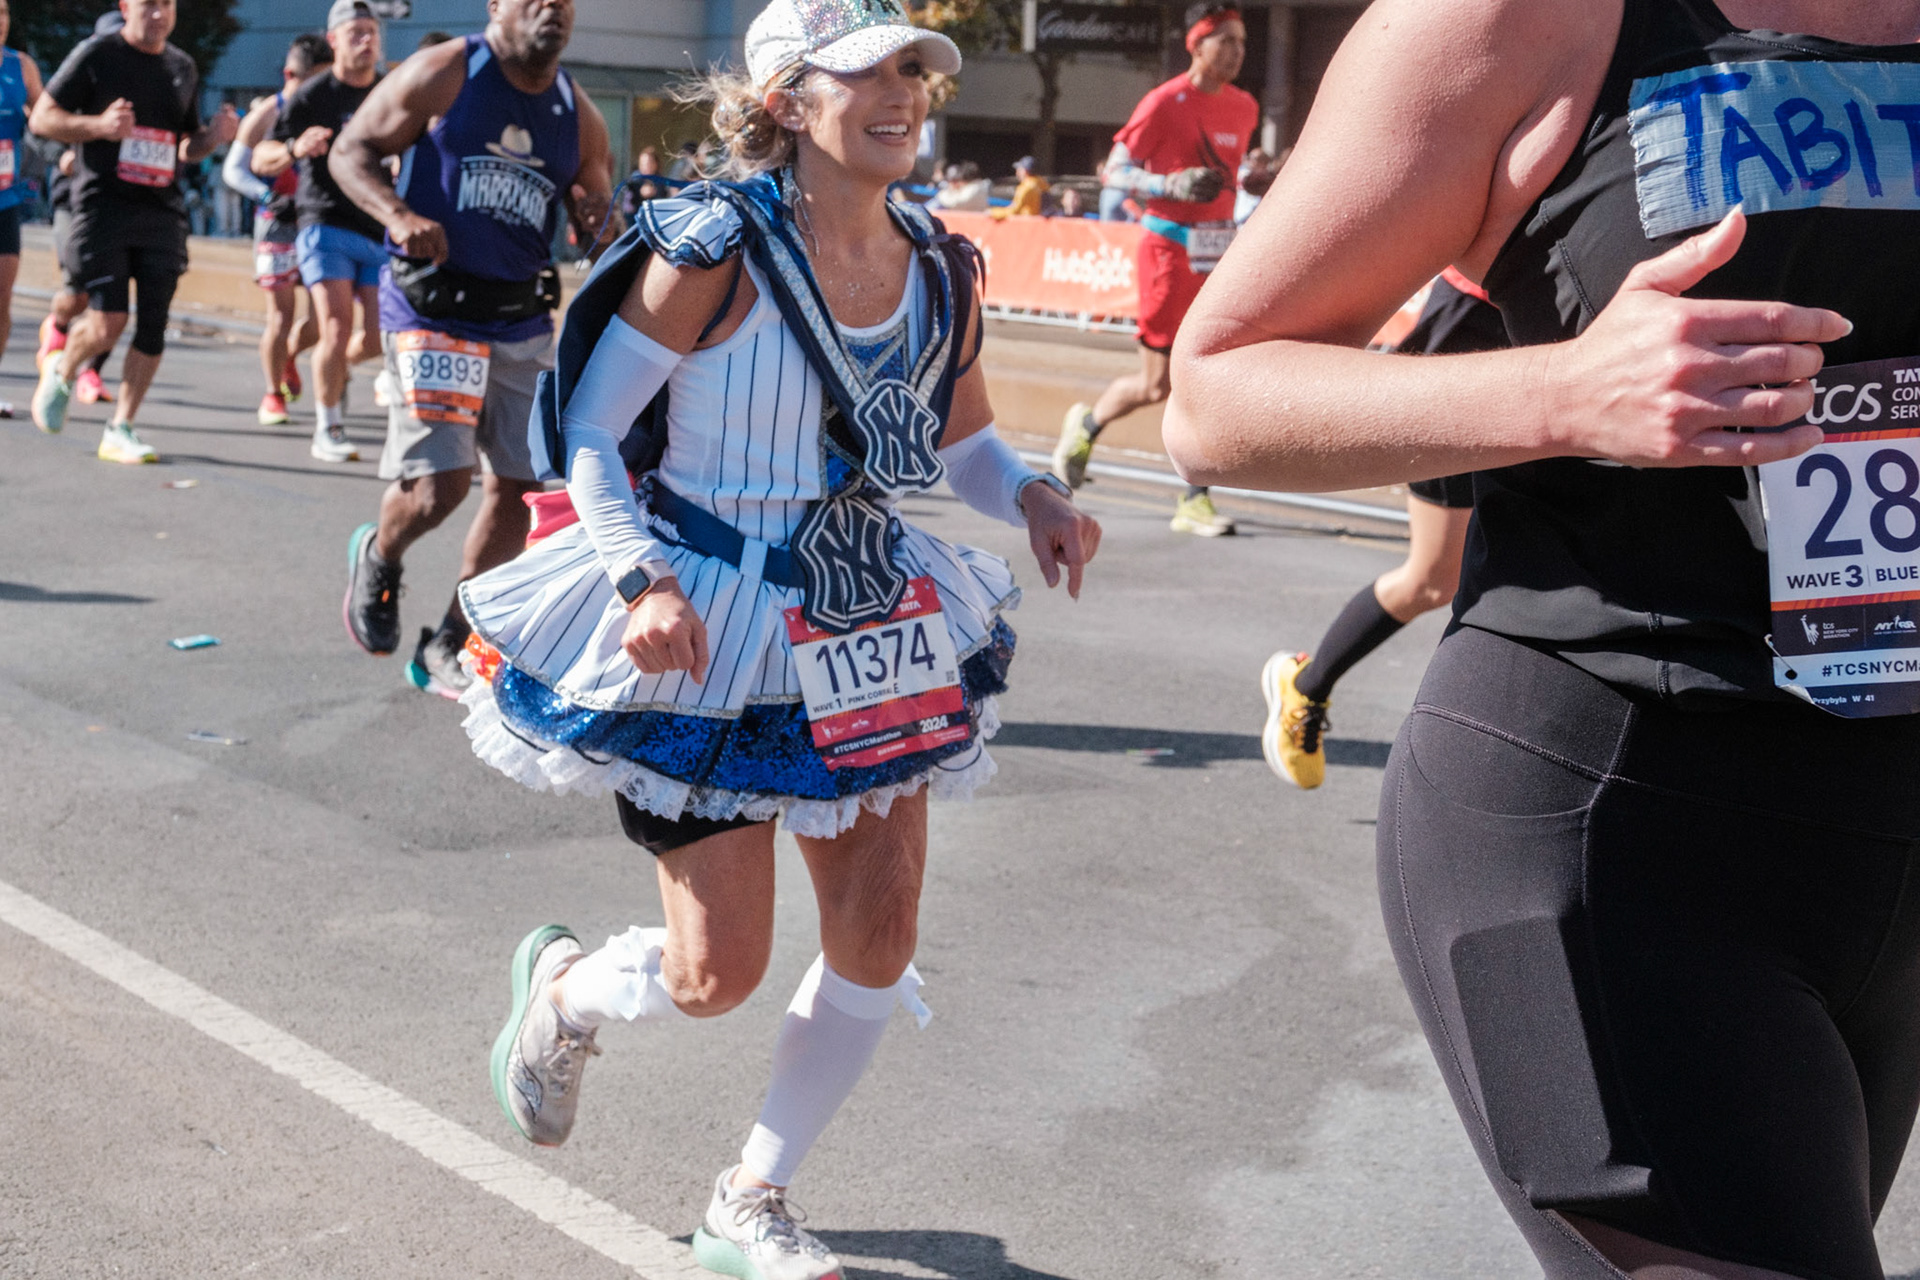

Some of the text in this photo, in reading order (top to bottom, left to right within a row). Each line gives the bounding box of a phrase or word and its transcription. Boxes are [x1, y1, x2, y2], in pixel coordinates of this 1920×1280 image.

[1647, 72, 1920, 211] TABIT
[1042, 244, 1133, 292] HubSpot
[404, 353, 484, 386] 39893
[1806, 378, 1883, 424] tcs
[865, 386, 942, 485] NY
[1796, 448, 1920, 560] 28
[809, 499, 899, 621] NY
[1786, 565, 1919, 589] WAVE 3 BLUE
[899, 601, 921, 612] TATA
[816, 621, 936, 695] 11374
[1822, 660, 1920, 677] #TCSNYCM
[813, 702, 834, 713] WAVE
[836, 698, 842, 708] 1
[848, 694, 866, 704] PINK
[893, 683, 900, 694] E
[1851, 694, 1861, 702] W
[920, 714, 949, 734] 2024
[834, 731, 901, 754] #TCSNYCMarathon
